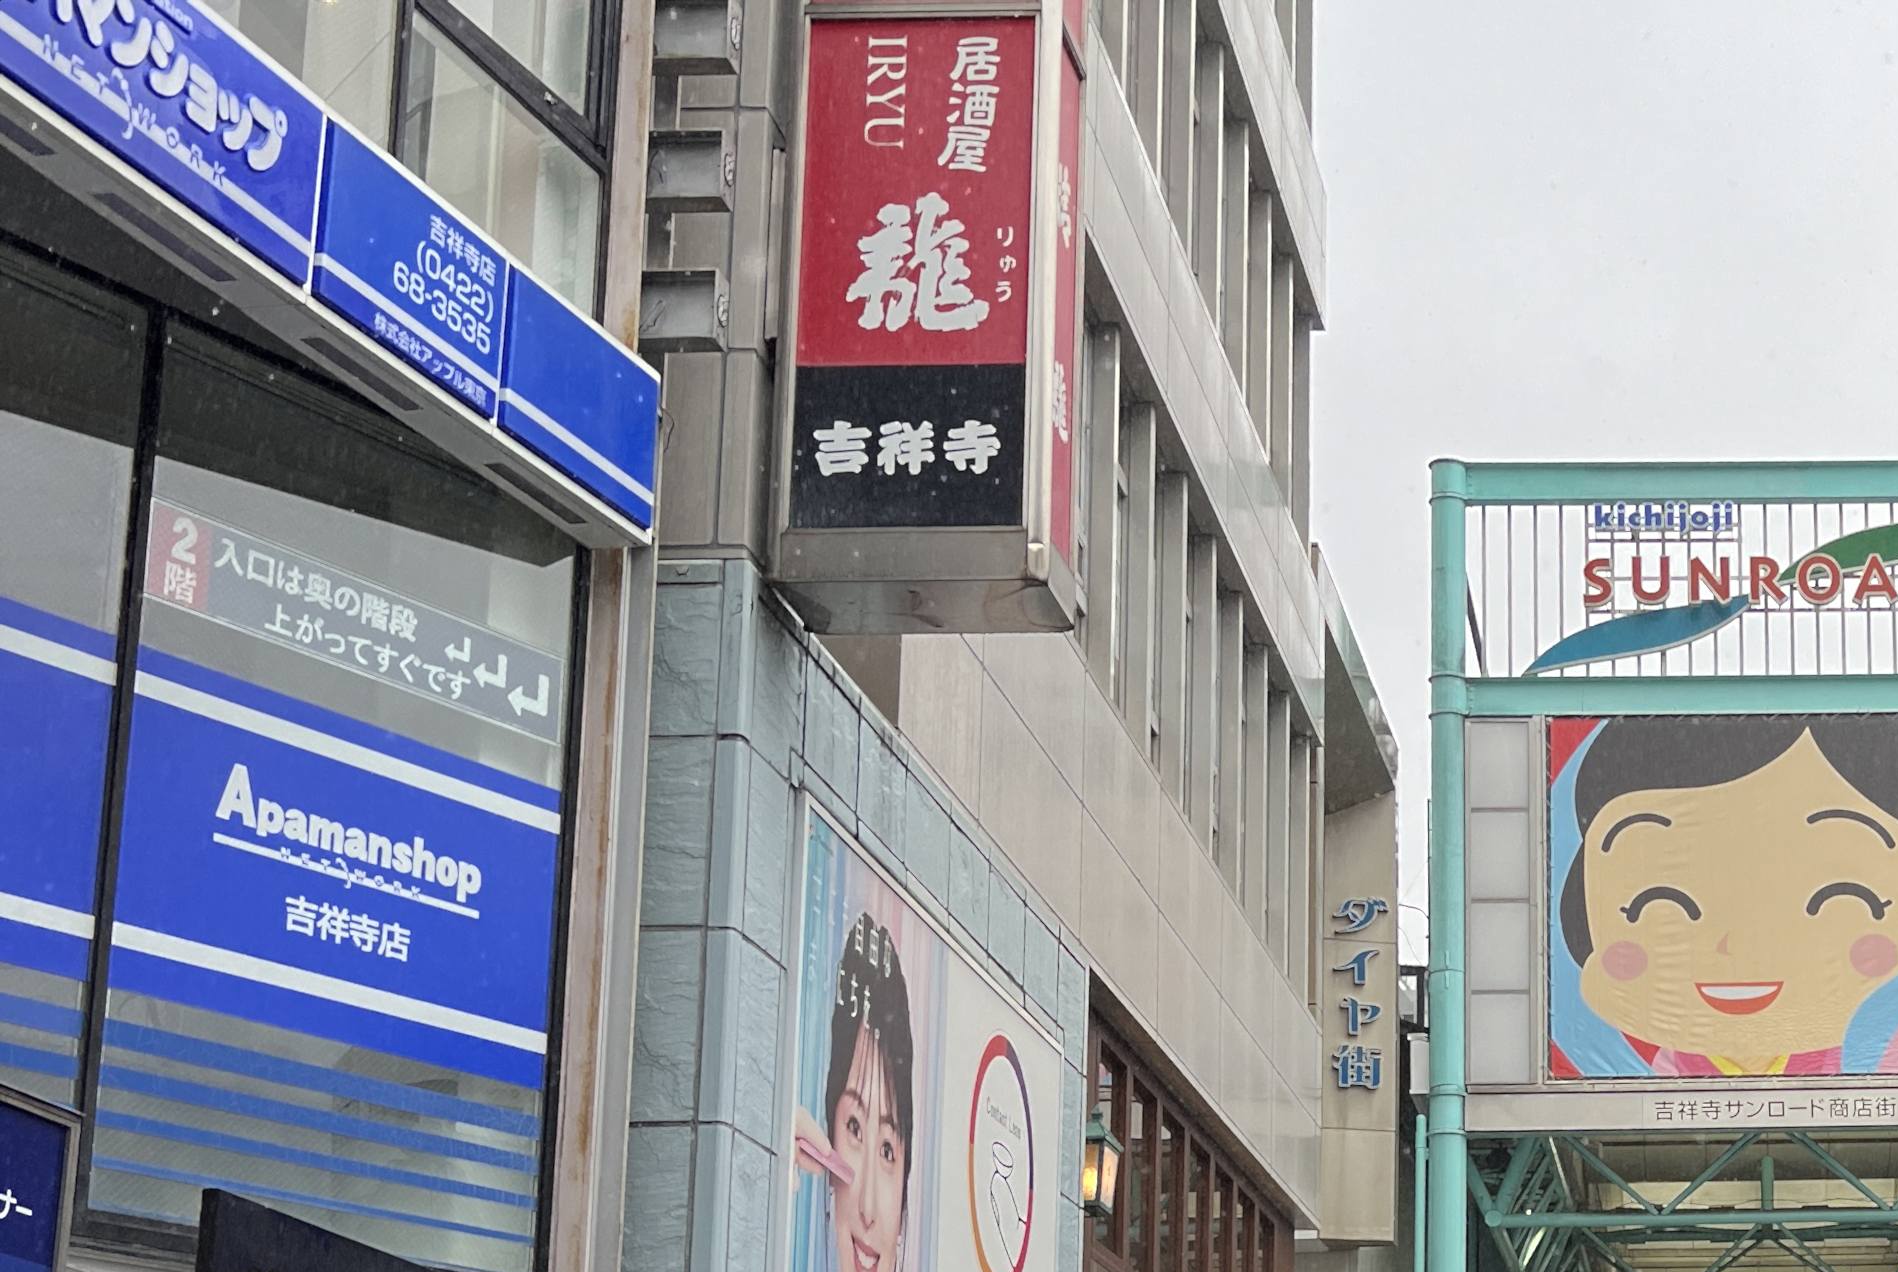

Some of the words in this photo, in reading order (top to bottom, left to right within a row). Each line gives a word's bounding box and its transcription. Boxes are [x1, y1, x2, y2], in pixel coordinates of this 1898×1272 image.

[864, 35, 907, 149] IRYU
[937, 36, 1000, 173] 居酒屋
[416, 240, 494, 323] (0422)
[430, 214, 497, 288] 吉祥寺店
[846, 191, 990, 332] 龍
[994, 226, 1017, 303] りゅう
[393, 261, 491, 355] 68-3535
[812, 419, 1001, 477] 吉祥寺
[1593, 501, 1734, 534] kichijoji
[214, 537, 418, 643] 入口は奥の階段
[264, 603, 472, 701] 上がってすぐです
[215, 763, 482, 903] Apamanshop
[285, 895, 411, 962] 吉祥寺店
[1332, 896, 1388, 1090] ダイヤ街
[1654, 1096, 1898, 1121] 吉祥寺サンロード商店街
